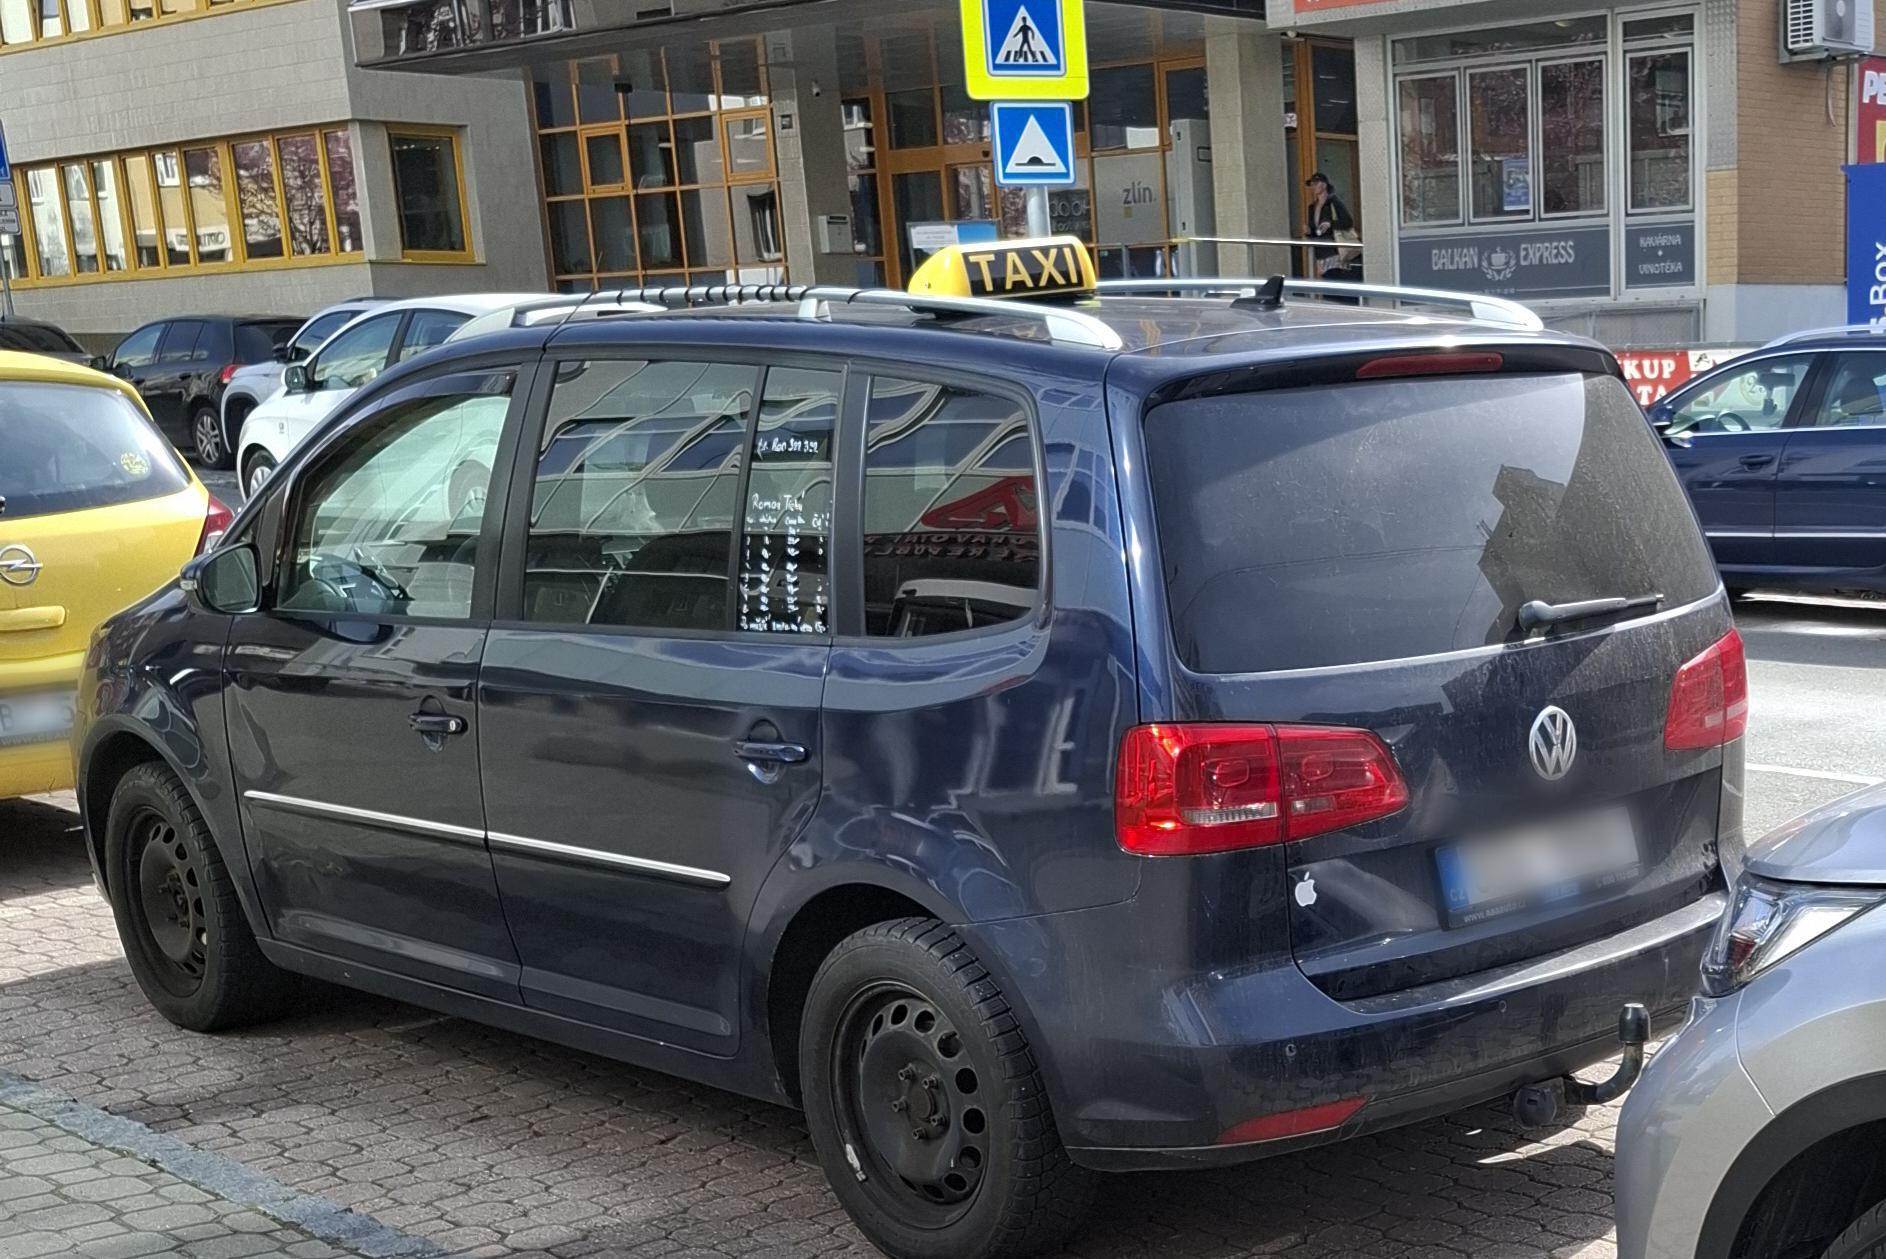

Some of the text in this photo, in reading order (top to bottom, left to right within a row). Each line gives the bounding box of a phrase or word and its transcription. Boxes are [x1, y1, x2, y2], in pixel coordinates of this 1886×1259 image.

[1122, 181, 1153, 205] zlín
[1639, 232, 1682, 248] KAVÁRNA
[1431, 240, 1575, 271] BALKAN EXPRESS
[968, 247, 1079, 292] TAXI
